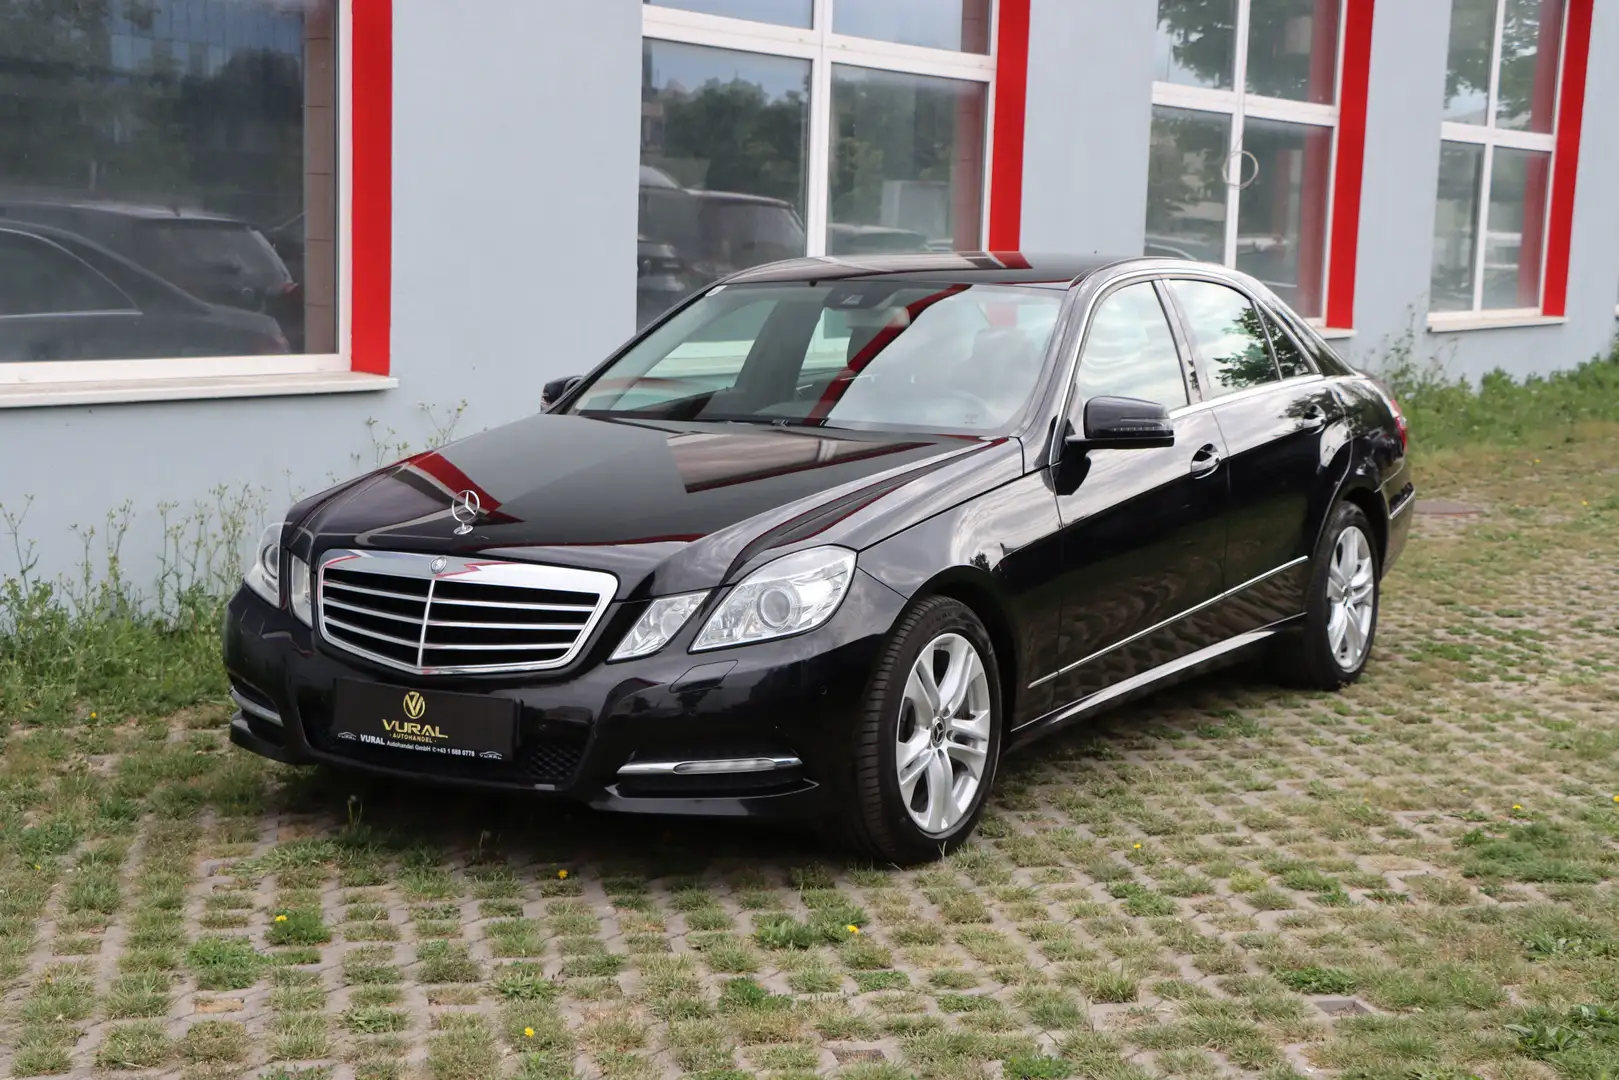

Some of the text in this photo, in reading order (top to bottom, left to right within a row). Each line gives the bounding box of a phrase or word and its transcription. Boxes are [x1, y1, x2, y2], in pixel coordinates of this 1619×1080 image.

[382, 719, 448, 738] VURAL
[392, 732, 433, 743] AUTOHANDEL
[360, 734, 385, 746] VURAL
[415, 744, 431, 752] GmbH
